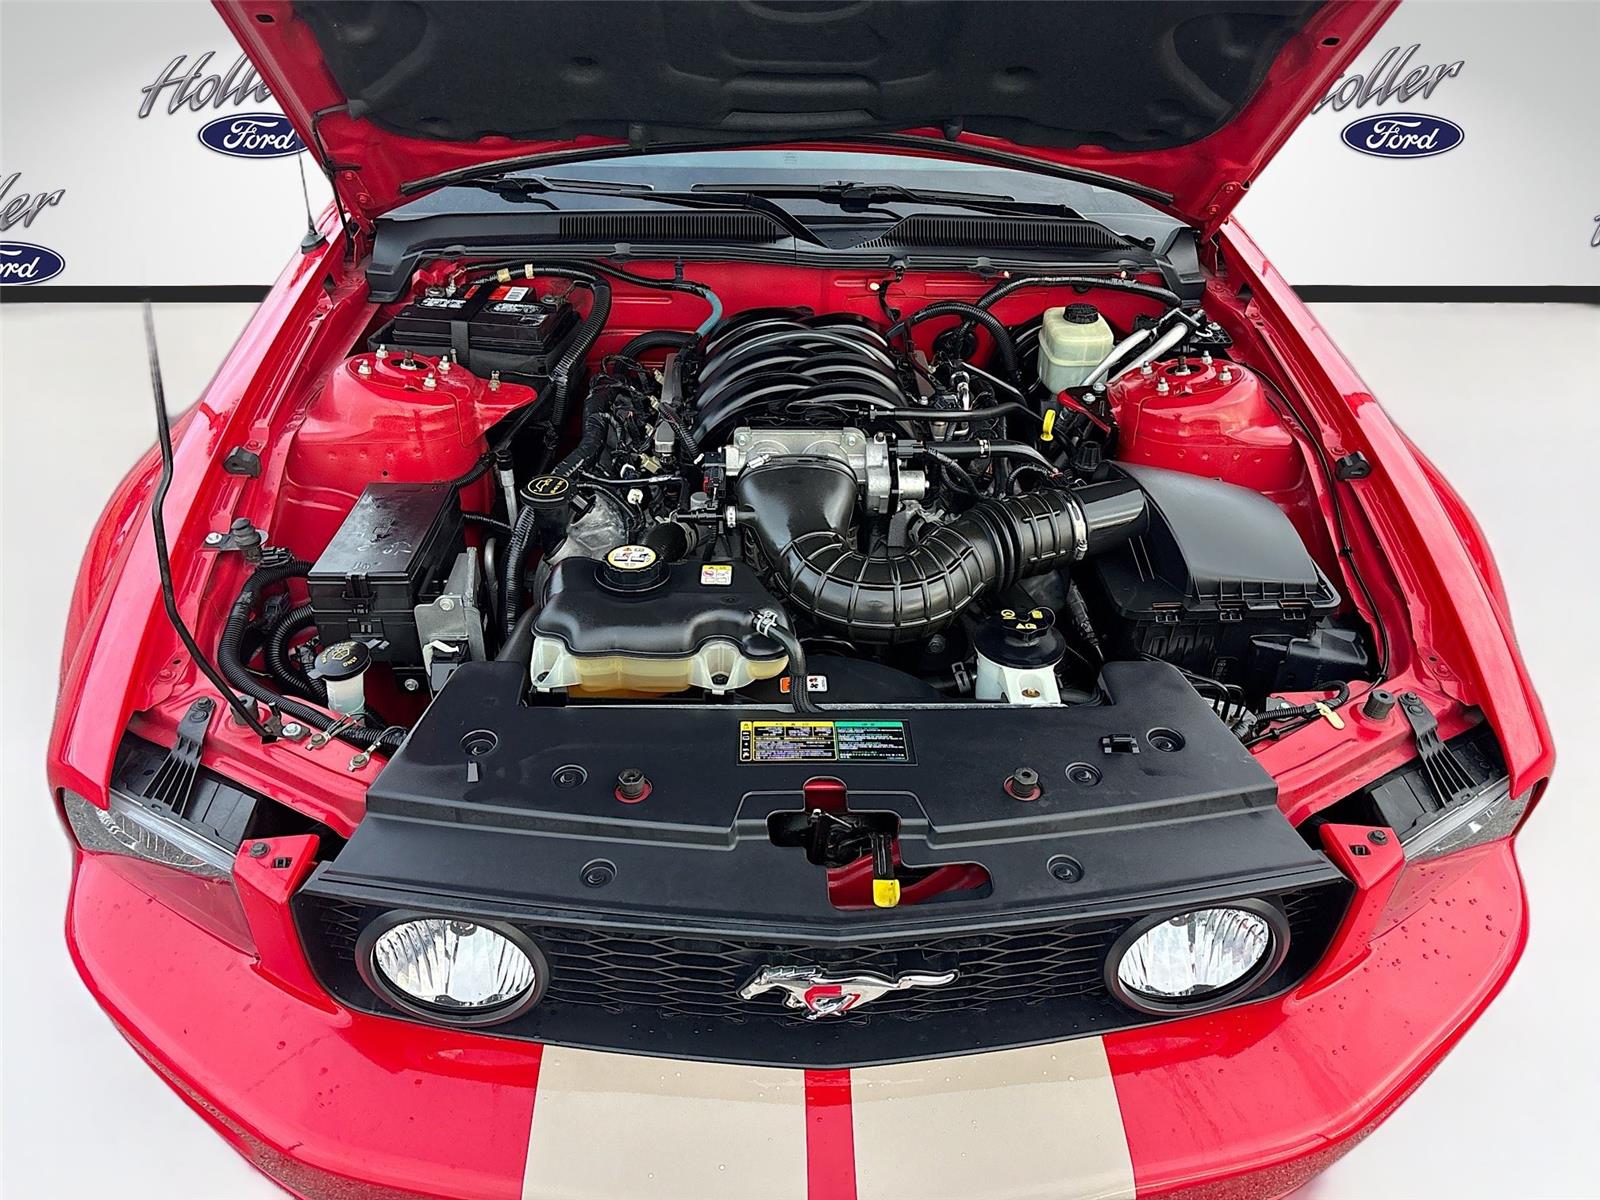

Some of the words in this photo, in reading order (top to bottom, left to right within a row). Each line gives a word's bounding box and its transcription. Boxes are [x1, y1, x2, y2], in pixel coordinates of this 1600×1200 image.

[138, 50, 273, 119] Holl
[223, 119, 295, 150] Ford
[1365, 119, 1440, 150] Ford
